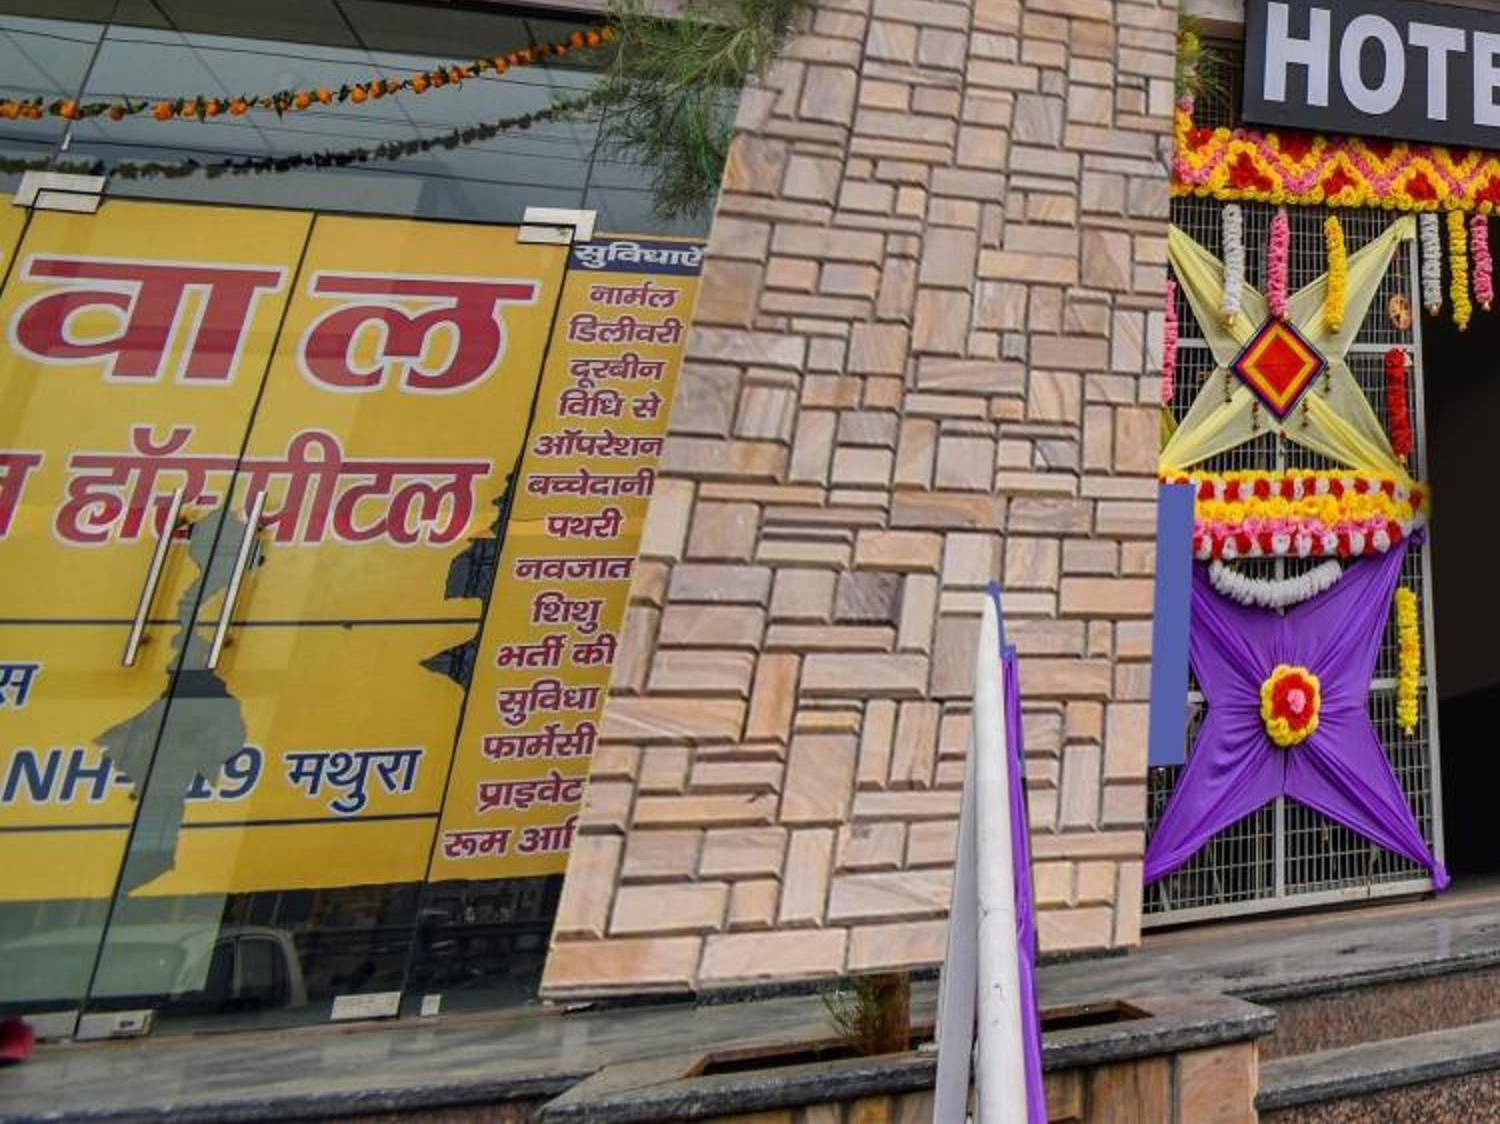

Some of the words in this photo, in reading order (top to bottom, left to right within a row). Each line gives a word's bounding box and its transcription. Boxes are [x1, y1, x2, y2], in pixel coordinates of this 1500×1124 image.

[590, 280, 679, 308] नार्मल
[569, 313, 685, 344] डिलीवरी
[570, 352, 666, 389] दूरबीन
[559, 389, 624, 418] विधि
[631, 391, 662, 418] से
[534, 429, 665, 457] ऑपरेशन
[527, 468, 655, 496] बच्चेदानी
[546, 507, 625, 539] पथरी
[515, 556, 636, 579] नवजात
[532, 590, 603, 635] शिशु
[497, 634, 566, 668] भर्ती
[571, 633, 617, 666] की
[497, 679, 601, 726] सुविधा
[483, 722, 598, 760] फार्मेसी
[286, 748, 423, 813] मथुरा
[478, 771, 587, 813] प्राइवेट
